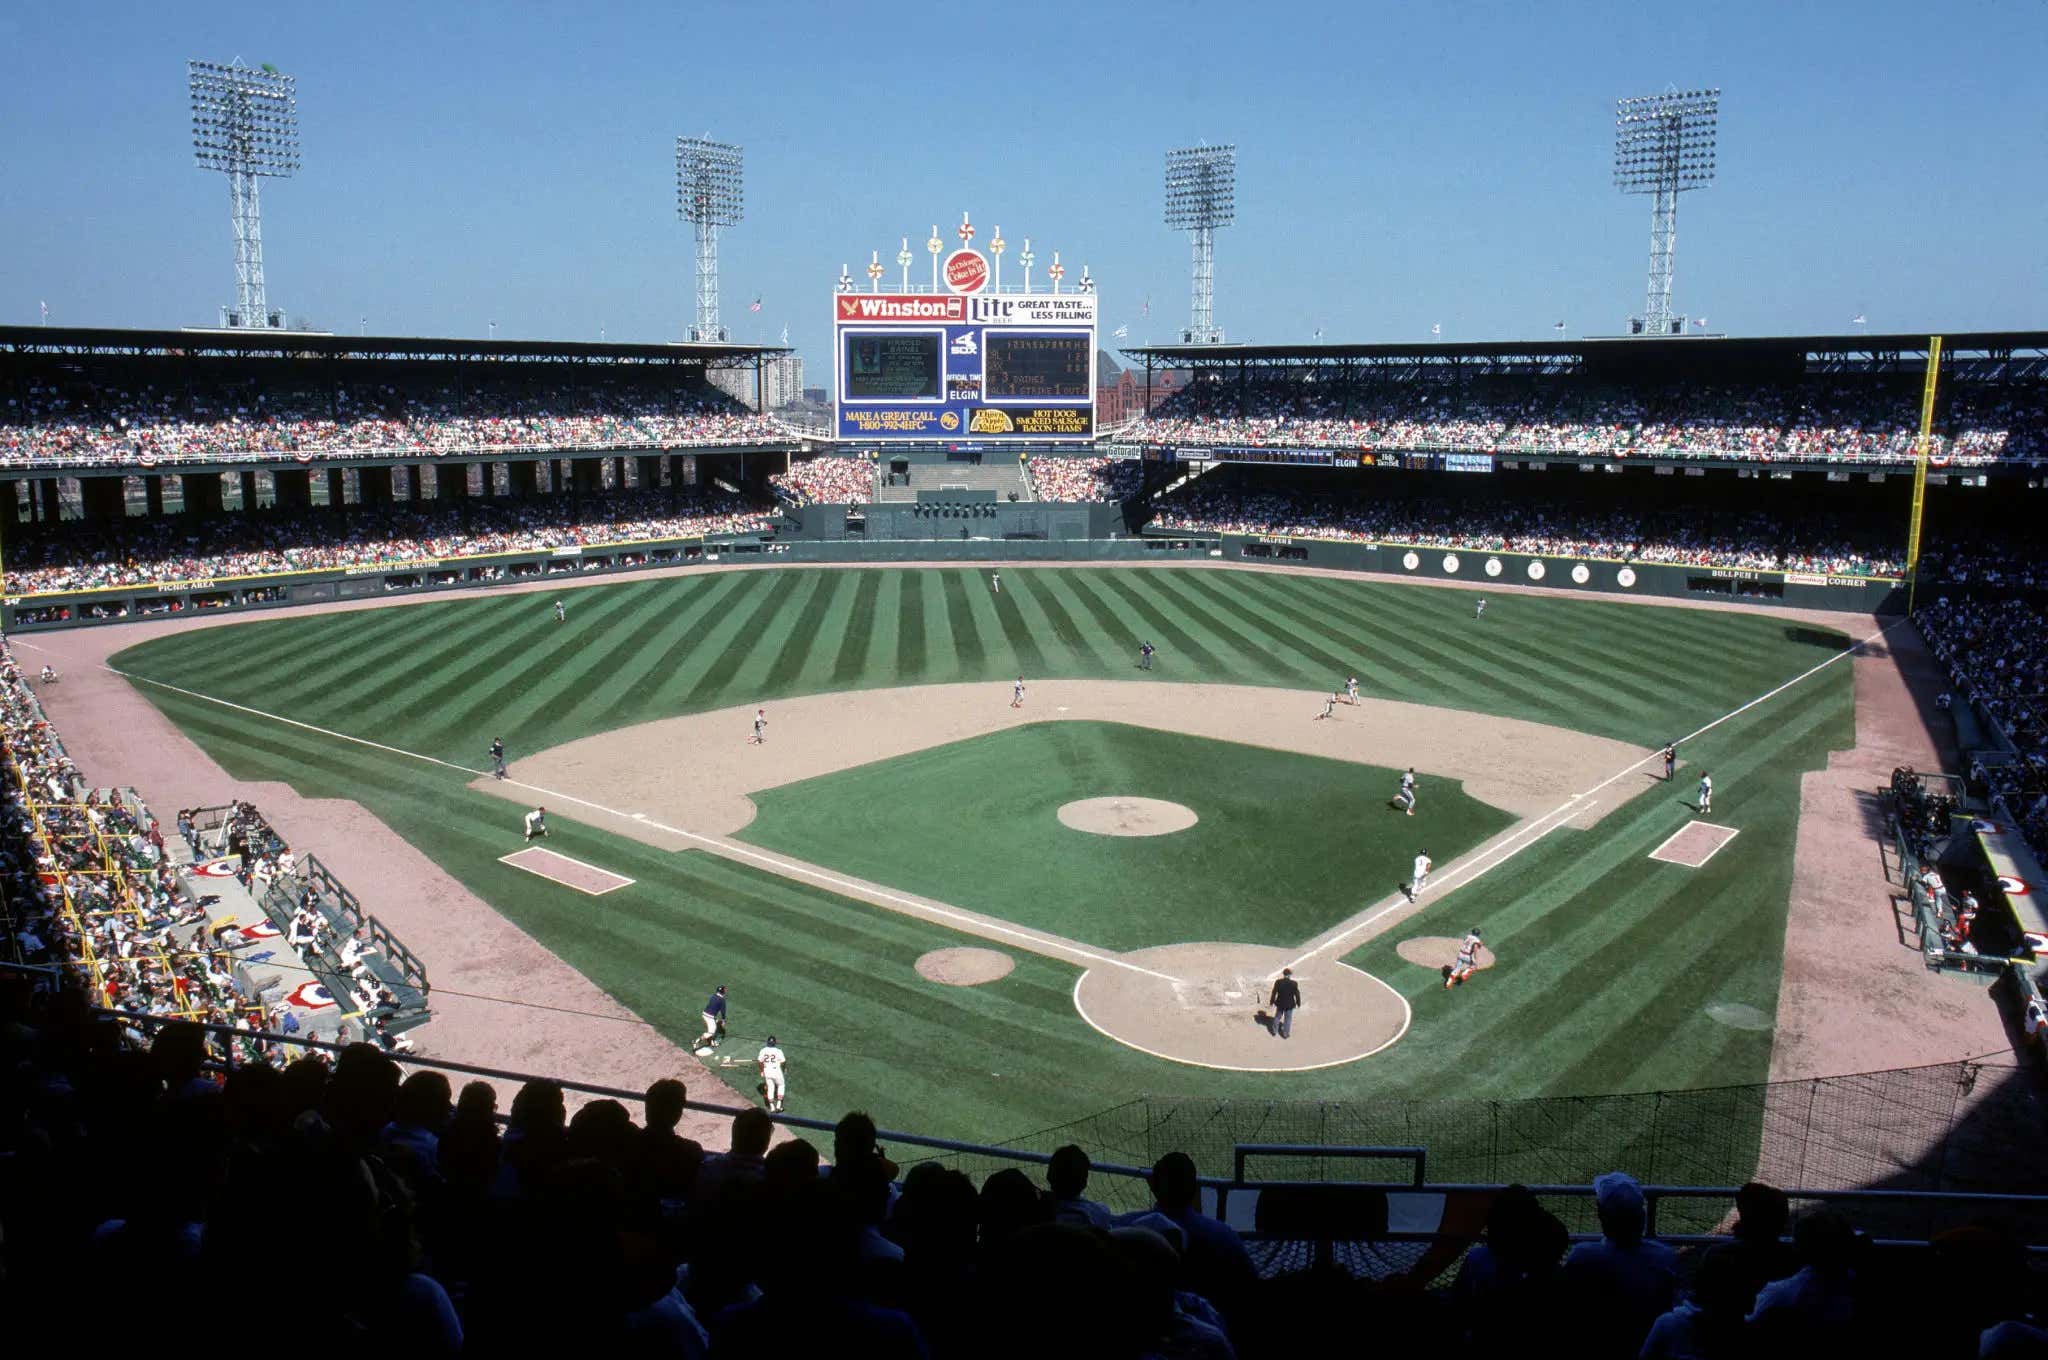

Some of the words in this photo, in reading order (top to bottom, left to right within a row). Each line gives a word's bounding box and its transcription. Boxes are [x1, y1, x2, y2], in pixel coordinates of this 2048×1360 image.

[948, 270, 969, 282] Coke
[968, 266, 976, 276] is
[860, 299, 946, 317] Winston
[1018, 301, 1049, 309] GREAT
[1052, 301, 1092, 309] TASTE...
[972, 298, 1013, 322] Lite
[1031, 311, 1053, 319] LESS
[1056, 311, 1092, 320] FILLING
[946, 373, 968, 381] OFFICIAL
[950, 391, 978, 400] ELGIN
[845, 412, 871, 421] MAKE
[871, 412, 880, 421] A
[881, 412, 911, 421] GREAT
[1033, 410, 1051, 418] HOT
[1051, 410, 1077, 418] DOGS
[1016, 417, 1051, 425] SMOKED
[1052, 417, 1088, 425] SAUSAGE
[1023, 424, 1052, 432] BACON
[1059, 424, 1082, 432] HAMS
[1108, 446, 1141, 457] Gatorade
[1335, 458, 1358, 467] ELGIN
[357, 565, 392, 574] GATORADE
[394, 563, 410, 571] KIDS
[412, 560, 440, 569] SECTION
[1712, 569, 1751, 580] BULLPEN
[158, 583, 188, 592] PICNIC
[190, 580, 215, 589] AREA
[1828, 577, 1866, 587] CORNER
[763, 1054, 776, 1063] 22
